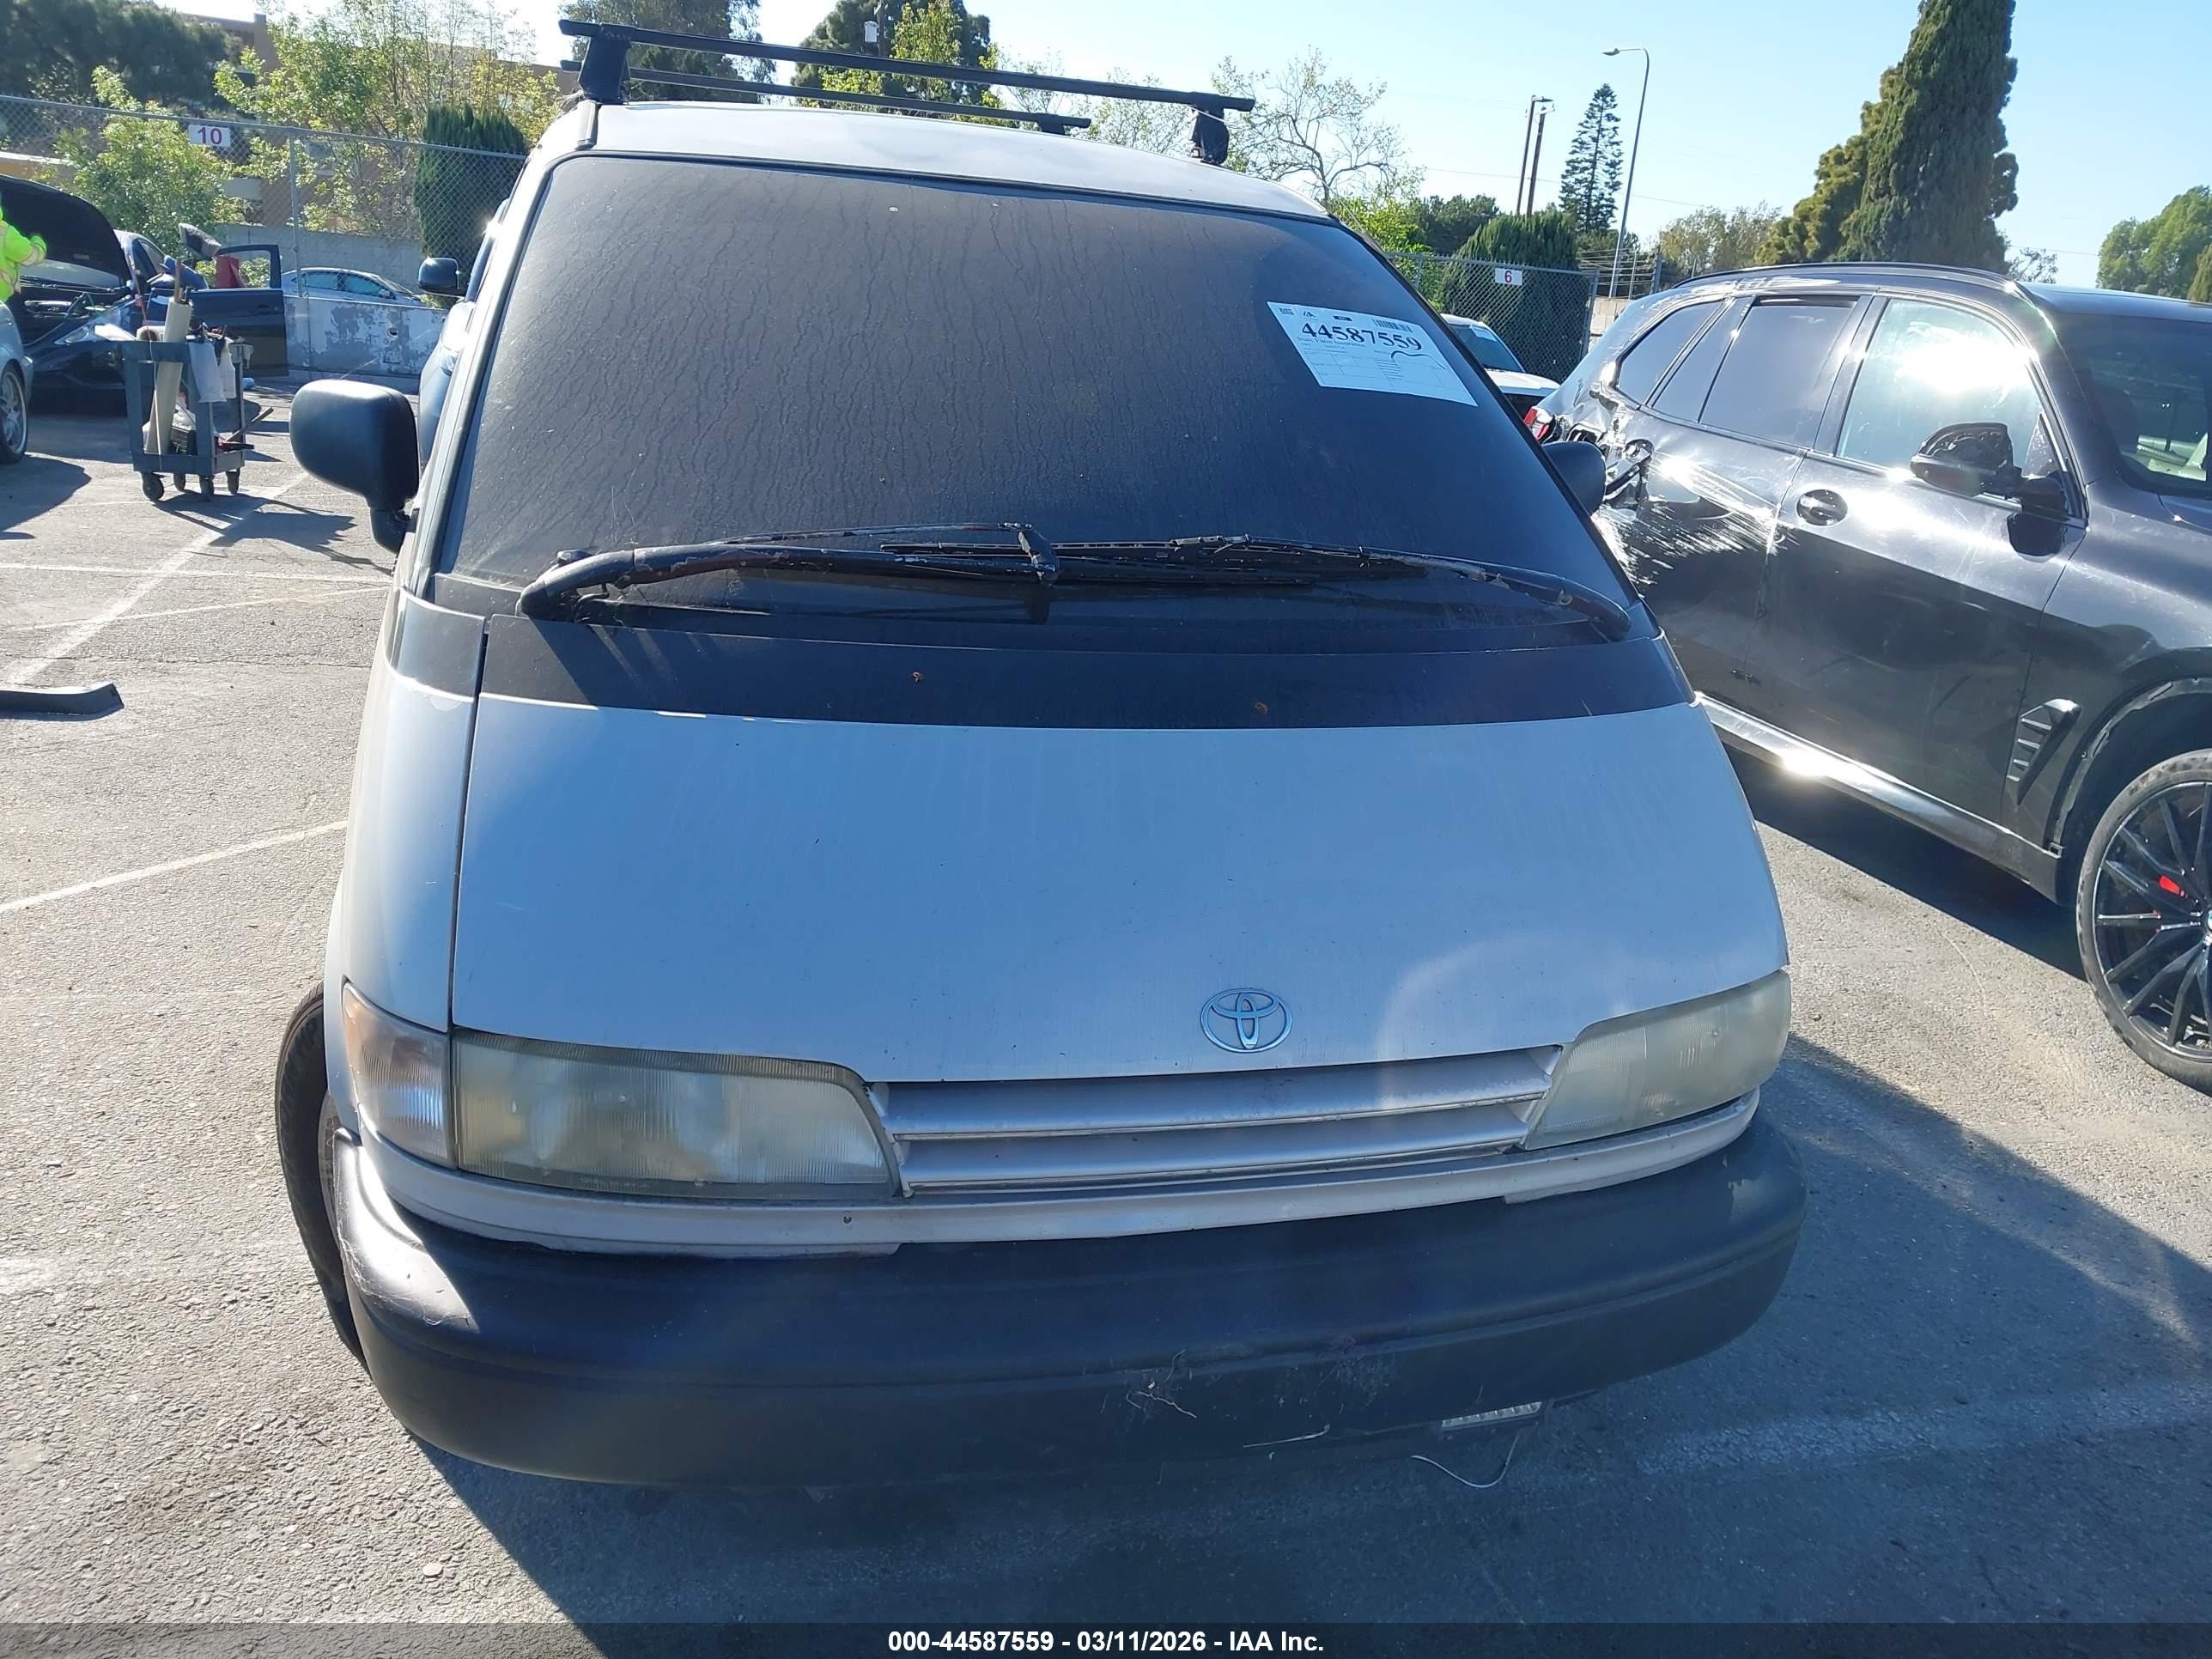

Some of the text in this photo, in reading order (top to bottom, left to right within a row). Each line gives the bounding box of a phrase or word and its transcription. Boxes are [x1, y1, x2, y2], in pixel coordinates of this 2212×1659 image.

[198, 126, 222, 145] 10
[1504, 270, 1512, 283] 6
[1302, 322, 1422, 350] 44587559
